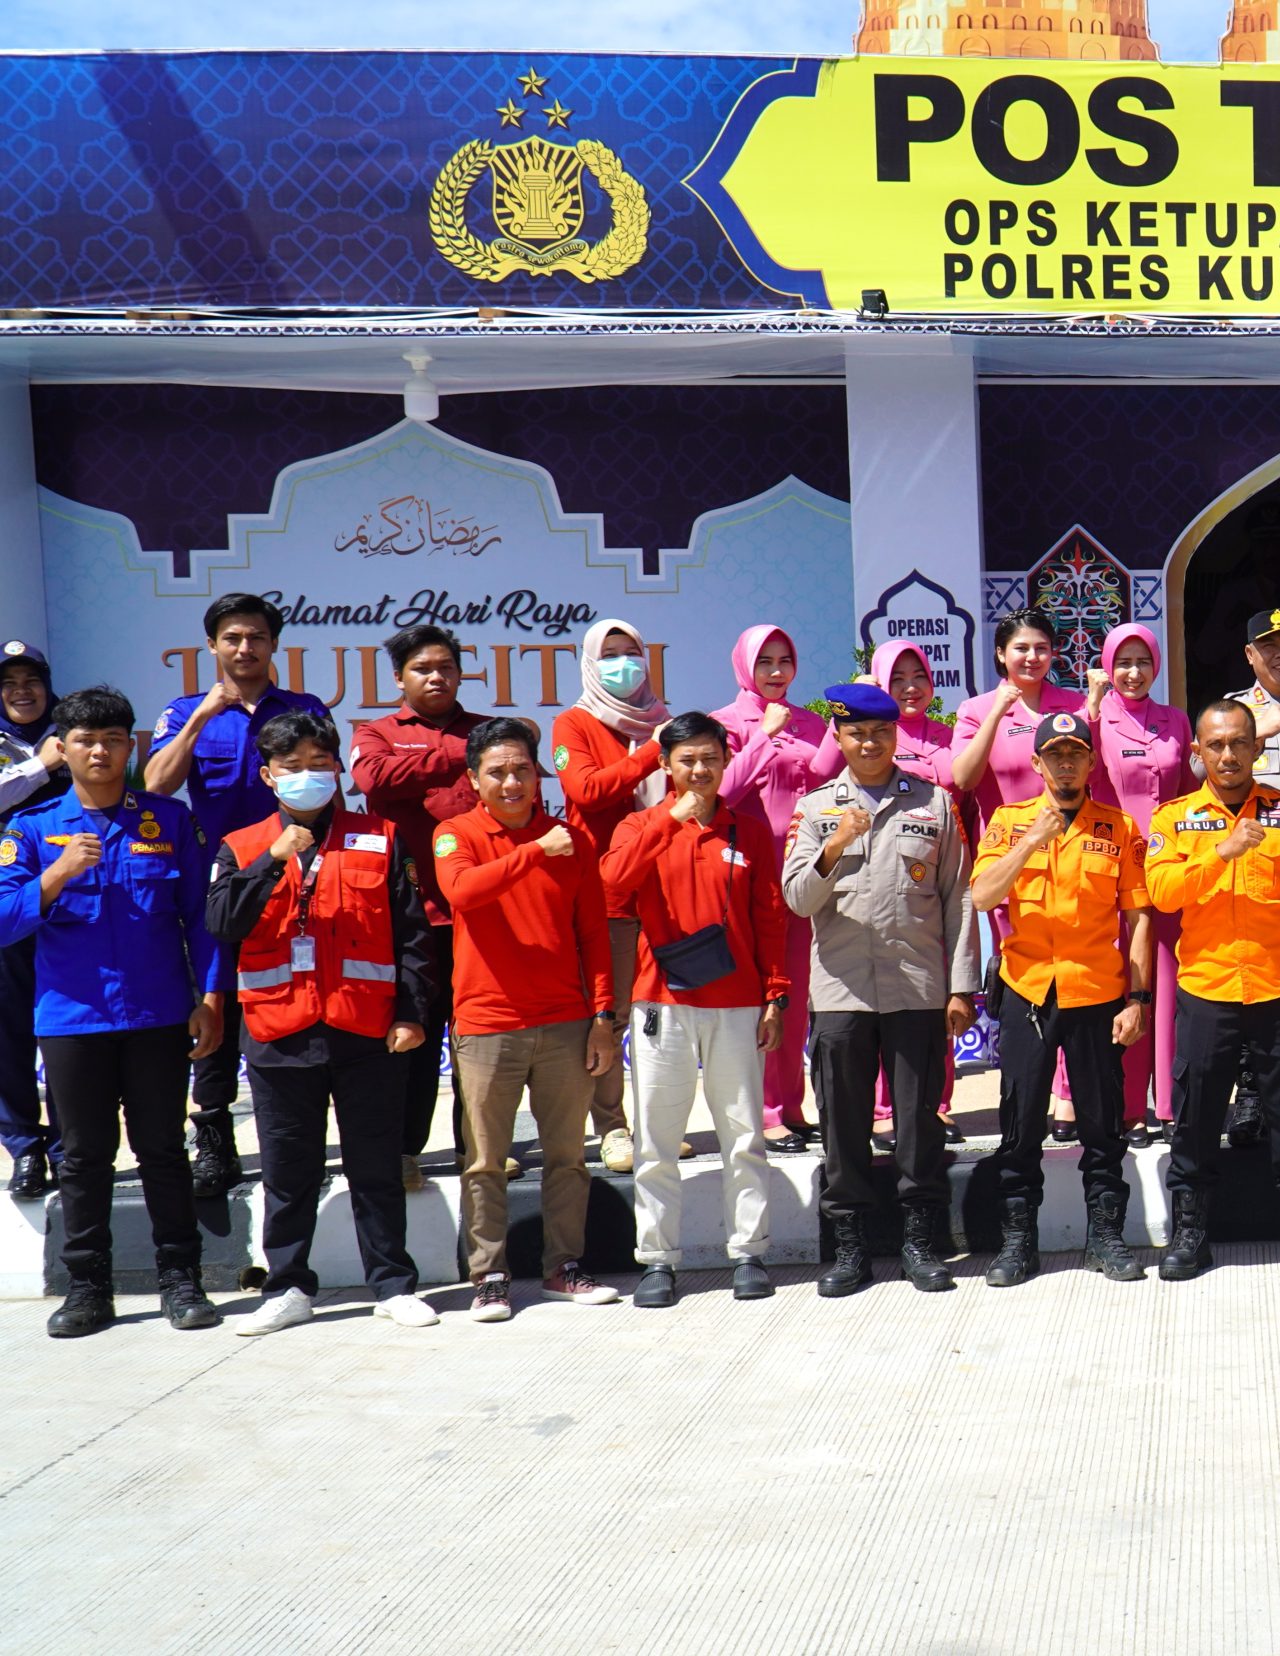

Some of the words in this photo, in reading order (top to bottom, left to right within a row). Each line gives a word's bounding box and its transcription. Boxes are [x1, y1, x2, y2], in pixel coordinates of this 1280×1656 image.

[873, 74, 1179, 186] POS
[944, 199, 1058, 247] OPS
[944, 253, 1170, 301] POLRES
[394, 589, 494, 628] Hari
[496, 589, 597, 637] Raya
[888, 618, 949, 637] OPERASI
[162, 646, 402, 709] IUL
[131, 842, 173, 854] PEMADAM
[902, 823, 938, 838] POLRI
[1086, 841, 1118, 855] BPBD
